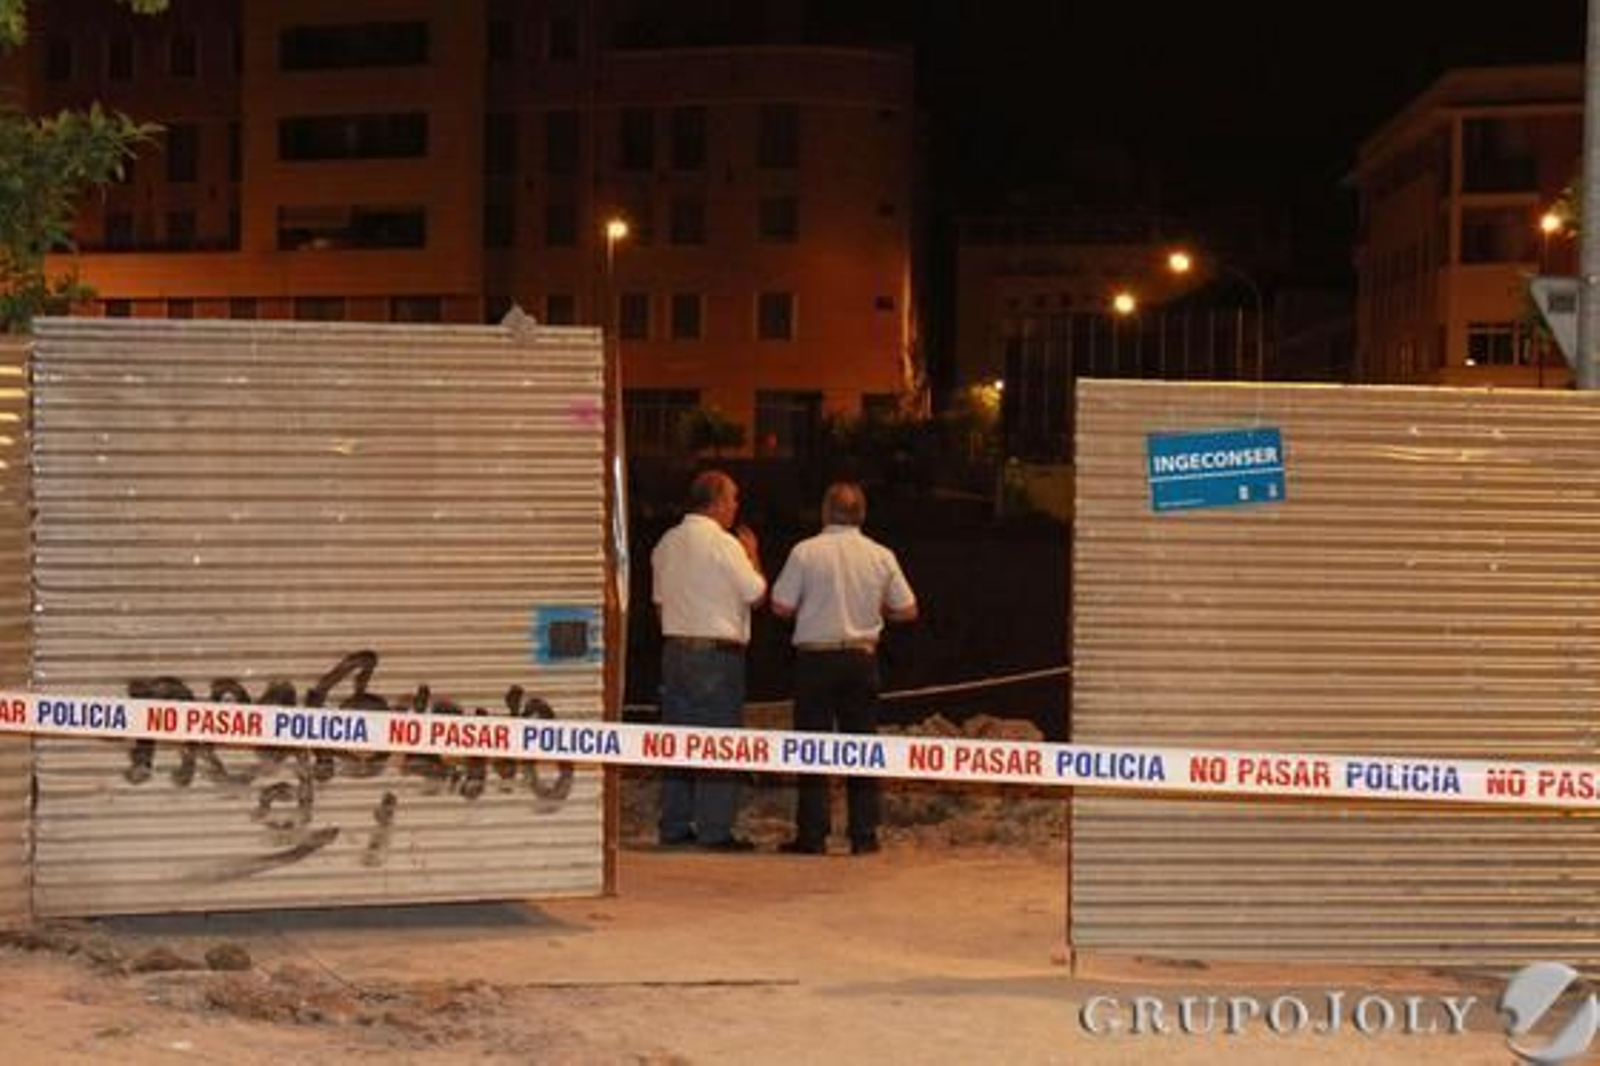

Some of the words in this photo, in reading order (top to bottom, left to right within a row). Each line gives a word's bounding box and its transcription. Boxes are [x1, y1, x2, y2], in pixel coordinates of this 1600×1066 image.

[1153, 447, 1278, 472] INGECONSER
[37, 702, 127, 729] POLICIA
[147, 707, 178, 733] NO
[187, 711, 263, 737] PASAR
[275, 714, 369, 742] POLICIA
[389, 720, 422, 745] NO
[430, 722, 510, 750] PASAR
[523, 726, 621, 756] POLICIA
[643, 733, 676, 759] NO
[685, 736, 770, 763] PASAR
[782, 738, 886, 769] POLICIA
[909, 745, 944, 772] NO
[954, 746, 1042, 775] PASAR
[1056, 751, 1165, 780] POLICIA
[1190, 757, 1226, 784] NO
[1238, 759, 1331, 789] PASAR
[1346, 763, 1461, 793] POLICIA
[1486, 769, 1526, 797] NO
[1538, 771, 1600, 799] PAS
